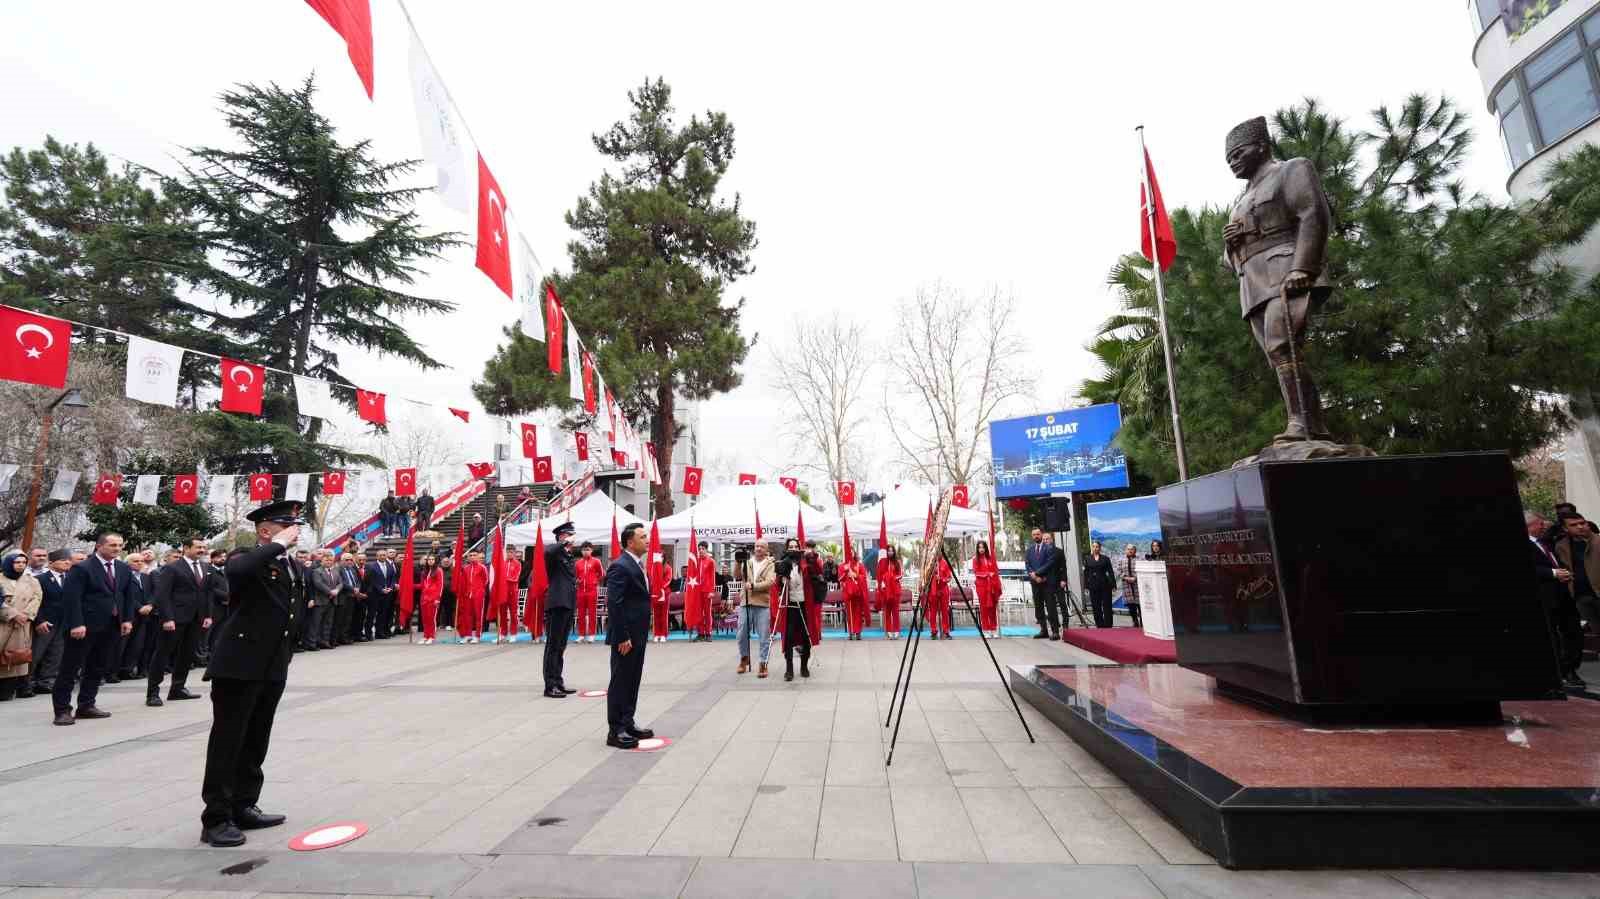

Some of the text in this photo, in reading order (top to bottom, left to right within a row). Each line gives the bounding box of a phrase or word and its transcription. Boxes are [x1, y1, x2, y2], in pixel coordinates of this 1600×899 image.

[1025, 422, 1078, 440] 17 ŞUBAT
[739, 526, 788, 535] BELDİYESİ
